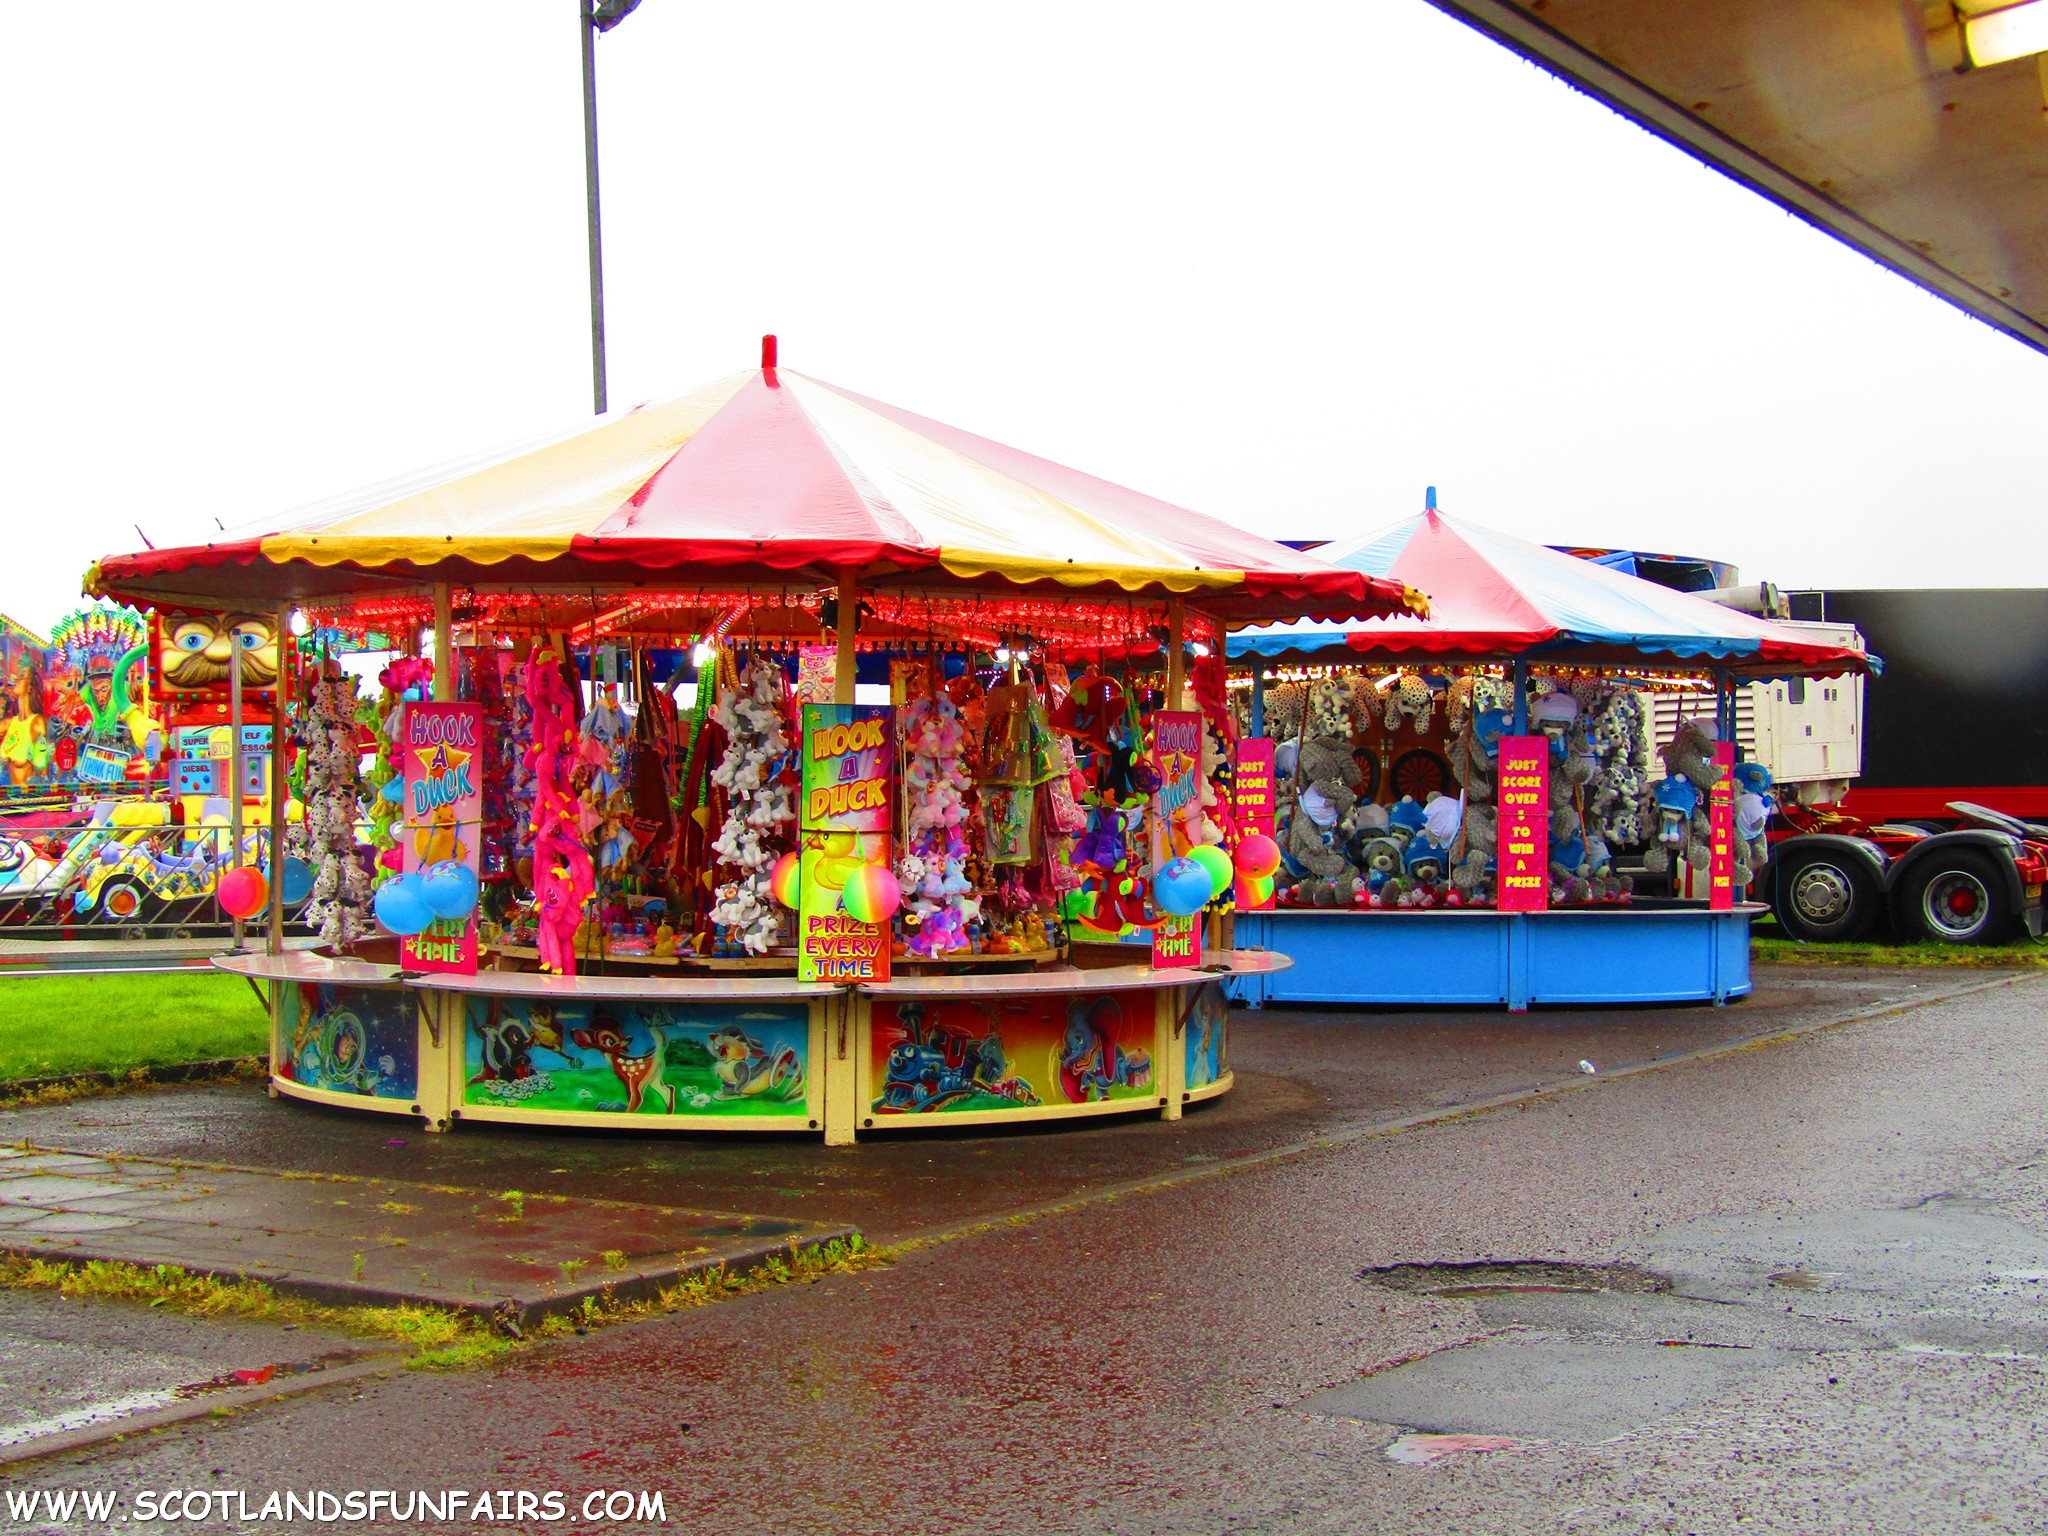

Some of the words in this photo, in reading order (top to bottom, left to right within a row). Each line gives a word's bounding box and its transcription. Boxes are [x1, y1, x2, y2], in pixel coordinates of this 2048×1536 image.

[410, 713, 476, 746] HOOK
[813, 717, 886, 762] HOOK
[1157, 722, 1199, 752] HOOK
[183, 737, 209, 745] SUPER
[212, 744, 230, 755] OIL
[430, 744, 449, 769] A
[1170, 751, 1181, 775] A
[1237, 761, 1265, 772] JUST
[1505, 759, 1538, 770] JUST
[183, 765, 210, 773] DIESEL
[838, 755, 859, 780] A
[411, 762, 475, 815] DUCK
[1502, 776, 1541, 787] SCORE
[809, 777, 887, 822] DUCK
[1158, 767, 1197, 818] DUCK
[1236, 794, 1266, 805] OVER
[1505, 793, 1538, 804] OVER
[1243, 826, 1260, 837] TO
[1512, 826, 1531, 837] TO
[1508, 843, 1534, 854] WIN
[1516, 859, 1526, 871] A
[1505, 876, 1541, 888] PRIZE
[423, 917, 470, 938] ERY
[807, 915, 879, 935] PRIZE
[805, 937, 882, 957] EVERY
[1161, 937, 1192, 957] TIME
[813, 958, 874, 978] TIME
